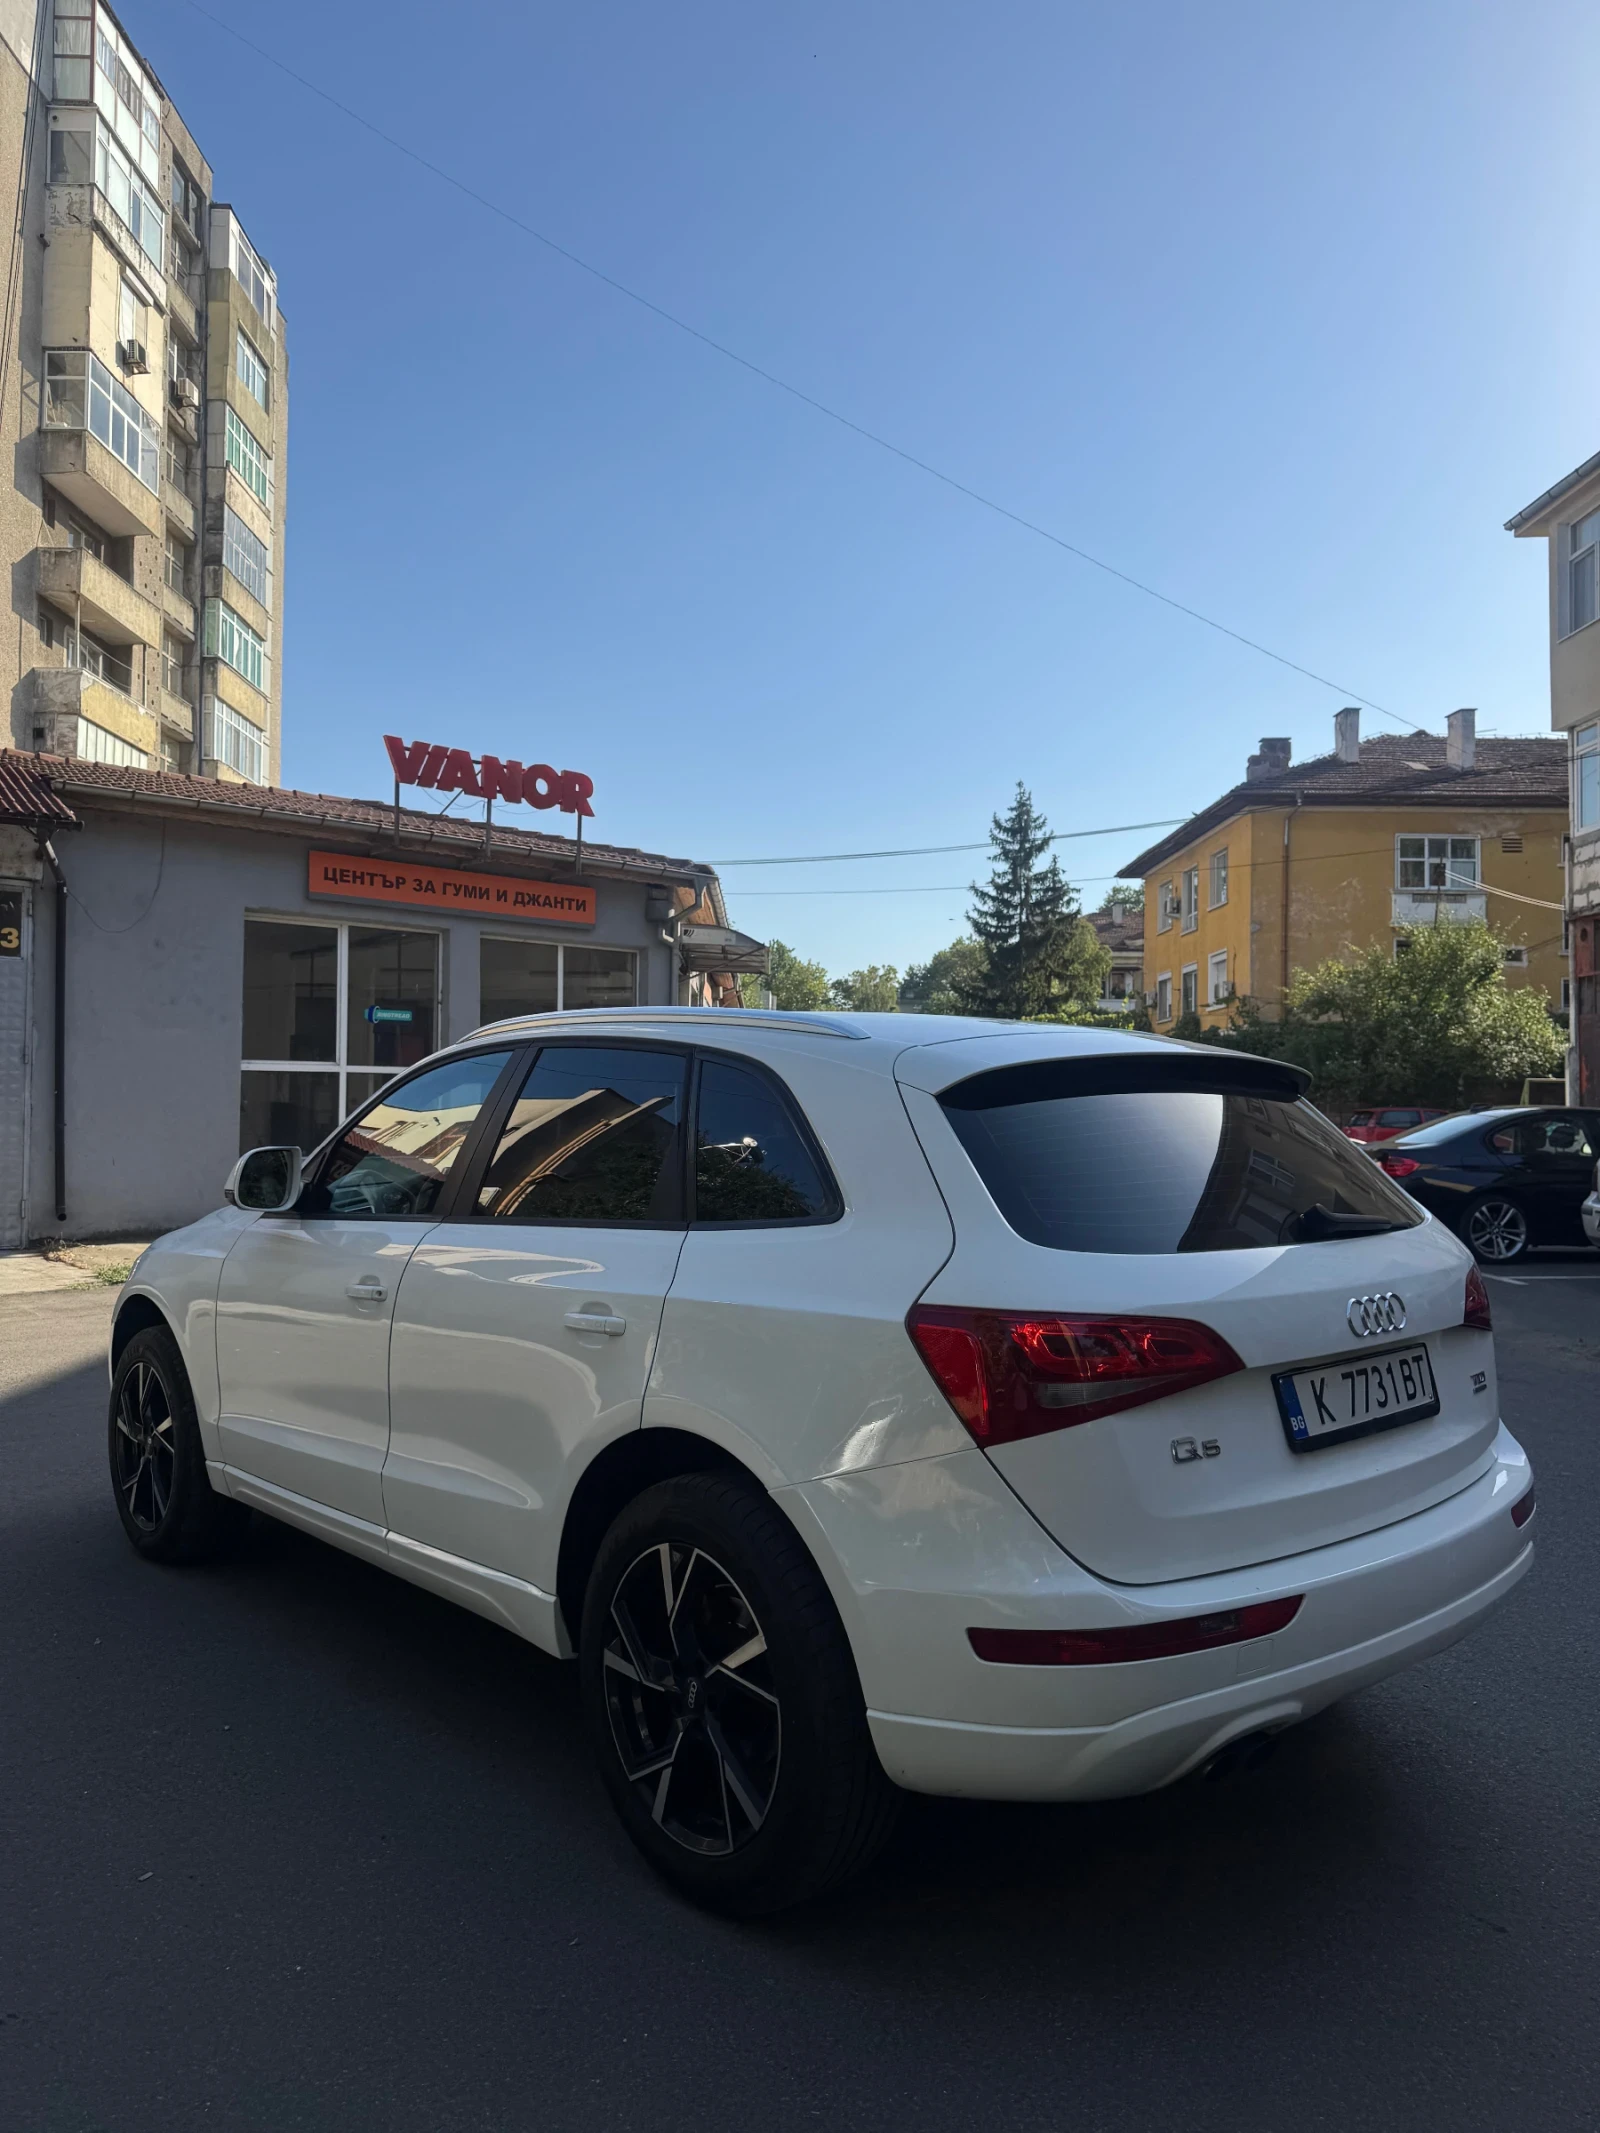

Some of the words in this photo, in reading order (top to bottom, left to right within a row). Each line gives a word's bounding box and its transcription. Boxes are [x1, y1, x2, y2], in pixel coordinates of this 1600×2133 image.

[383, 735, 595, 817] VIANOR
[323, 866, 407, 889] ЦЕНТЪР
[412, 878, 436, 894] ЗА
[442, 882, 490, 901] ГУМИ
[496, 889, 508, 903] И
[512, 891, 587, 913] ДЖАНТИ
[0, 927, 20, 949] 3
[1310, 1376, 1337, 1425] K
[1290, 1415, 1305, 1431] BG
[1170, 1435, 1221, 1464] Q5
